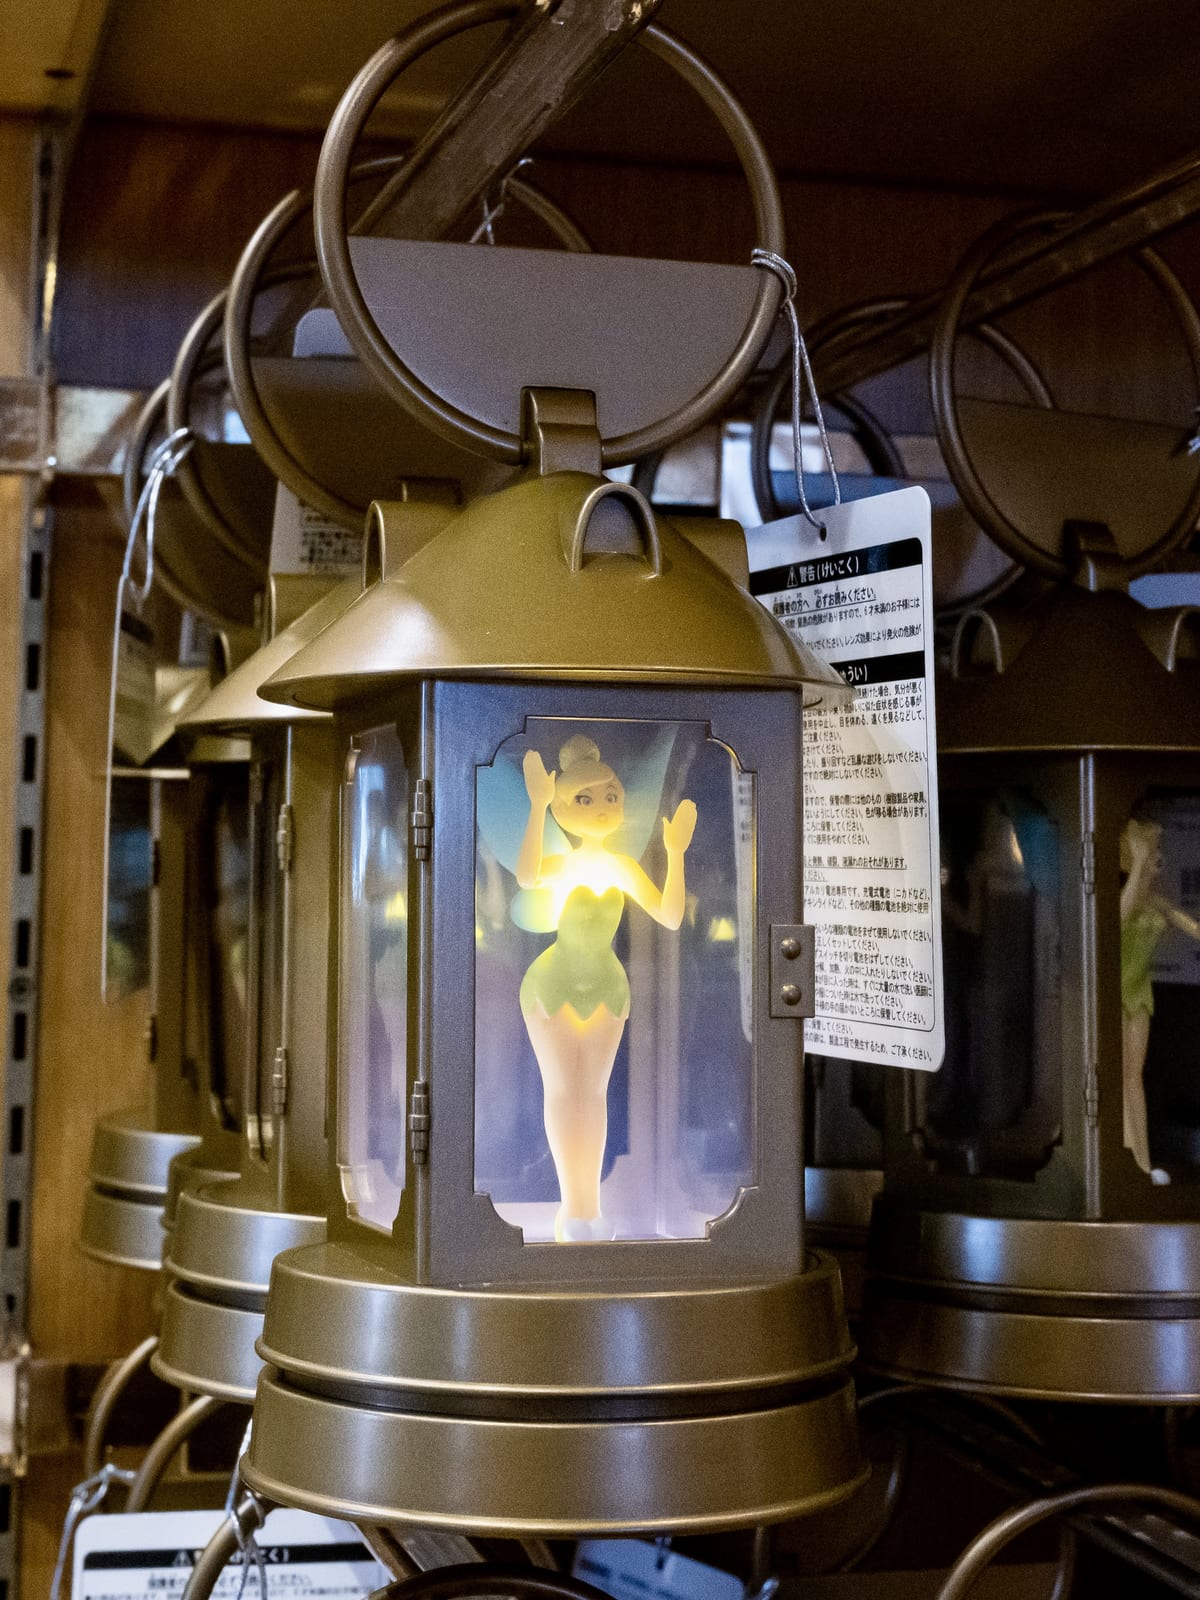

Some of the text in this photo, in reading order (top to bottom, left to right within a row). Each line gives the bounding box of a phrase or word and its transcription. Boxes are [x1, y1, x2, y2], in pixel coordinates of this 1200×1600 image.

[816, 586, 876, 609] 必ずお読みください。
[804, 834, 870, 846] ぐに使用をやめてください。
